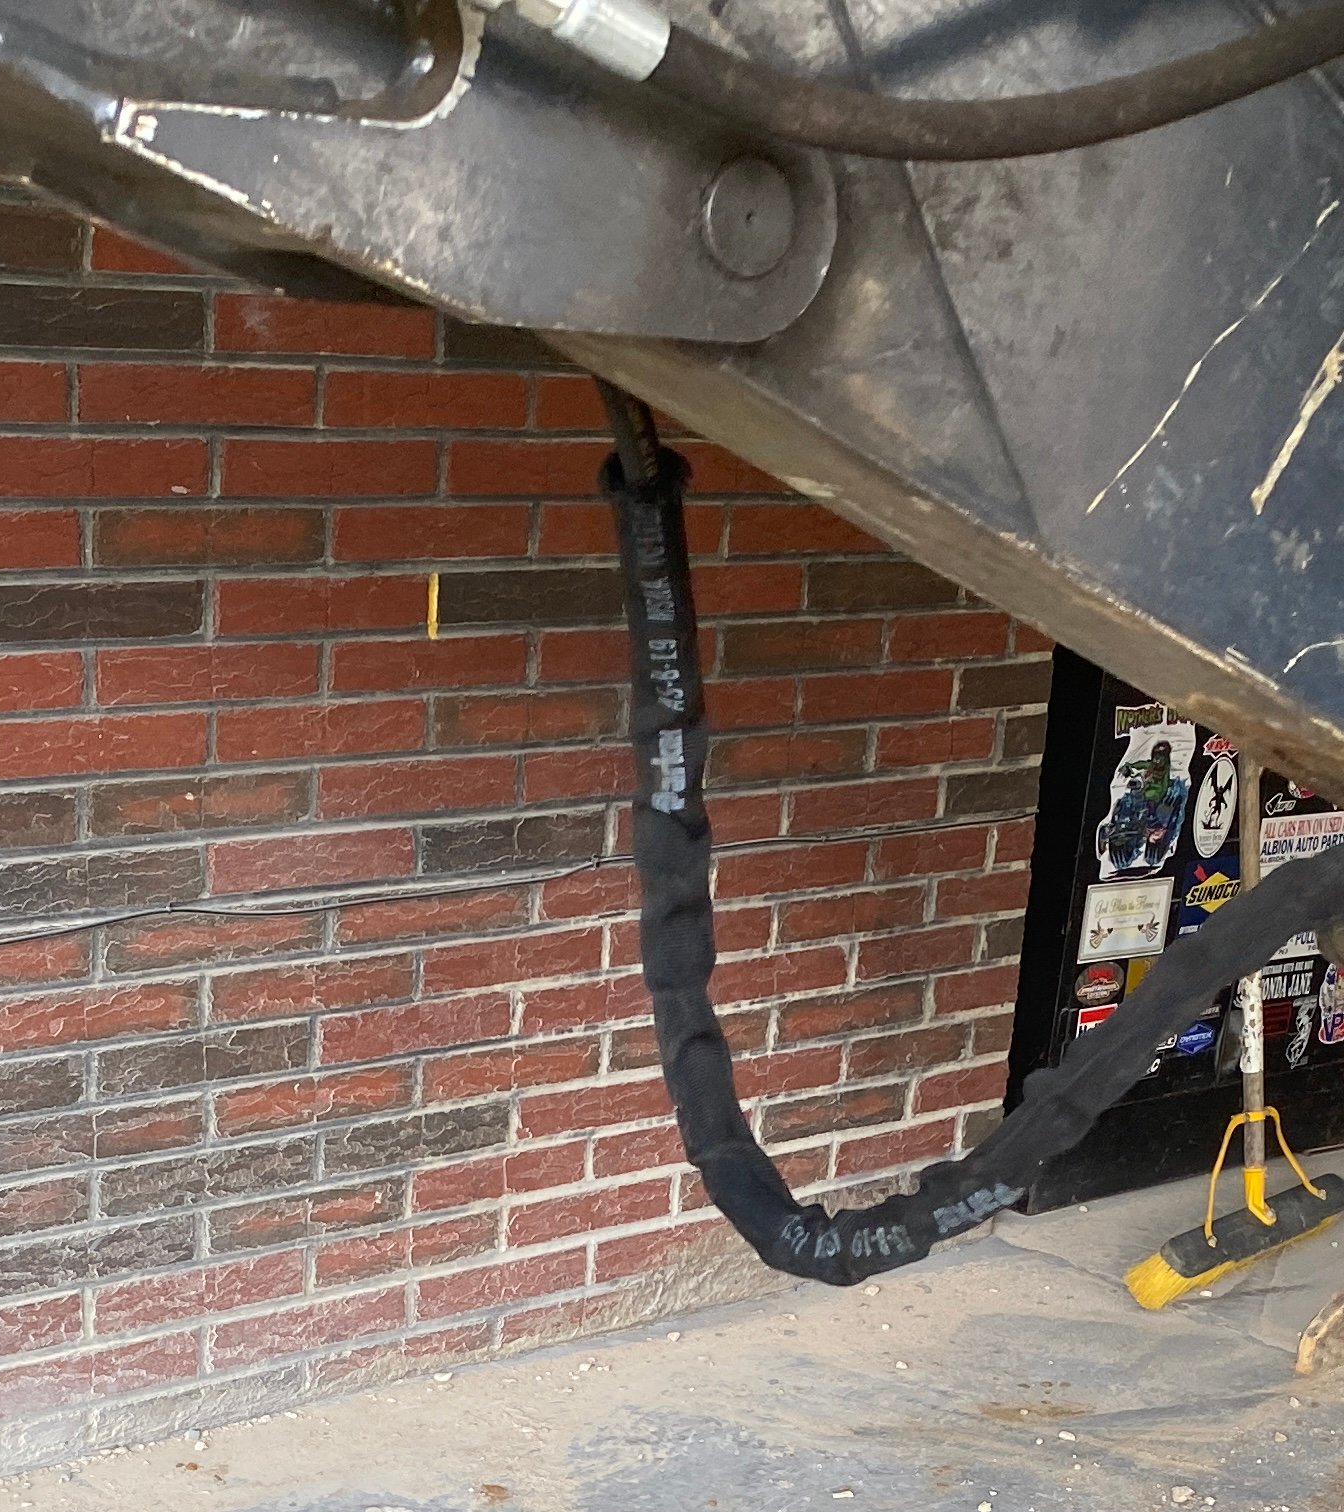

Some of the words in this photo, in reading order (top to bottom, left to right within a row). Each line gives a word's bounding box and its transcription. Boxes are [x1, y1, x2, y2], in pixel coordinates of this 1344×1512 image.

[1261, 839, 1294, 856] ALBION
[1295, 836, 1319, 852] AUTO
[1188, 882, 1240, 904] SUNOCO
